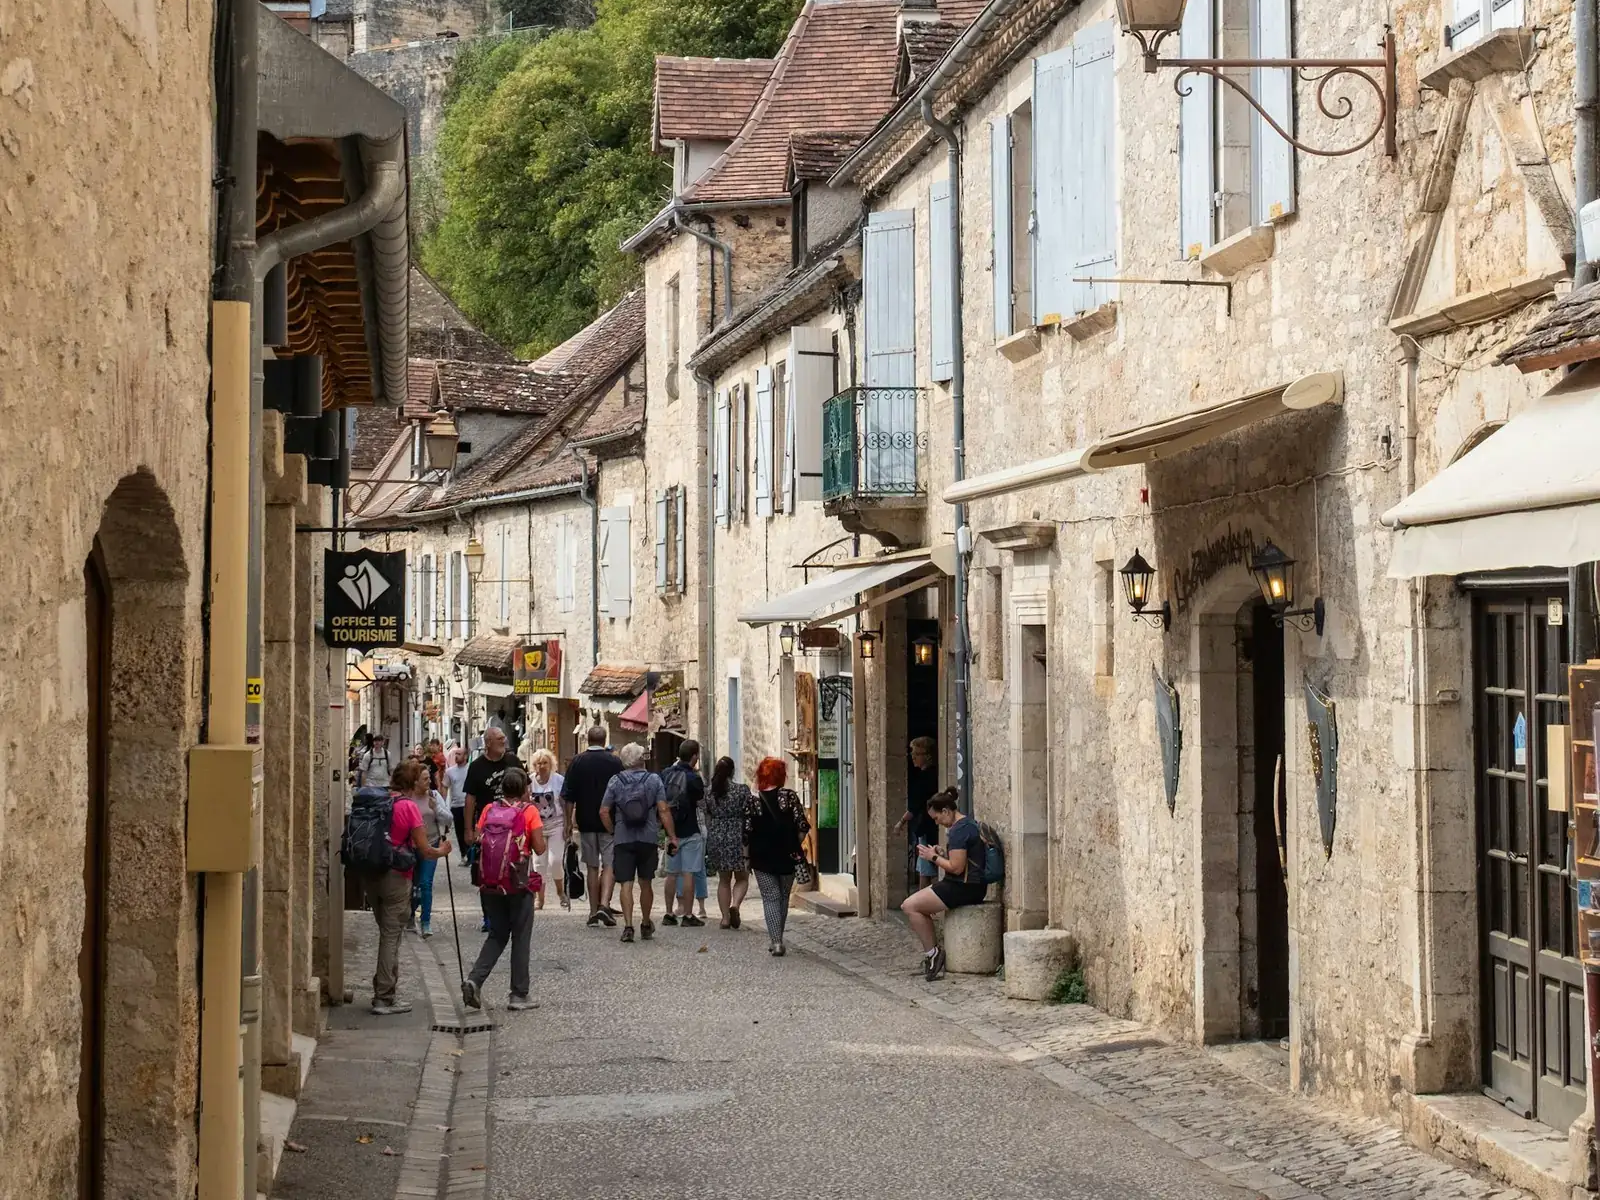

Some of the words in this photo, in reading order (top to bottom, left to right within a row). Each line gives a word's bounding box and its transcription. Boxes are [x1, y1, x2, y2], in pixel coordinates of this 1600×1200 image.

[332, 616, 375, 627] OFFICE
[379, 616, 397, 627] DE
[332, 629, 397, 642] TOURISME
